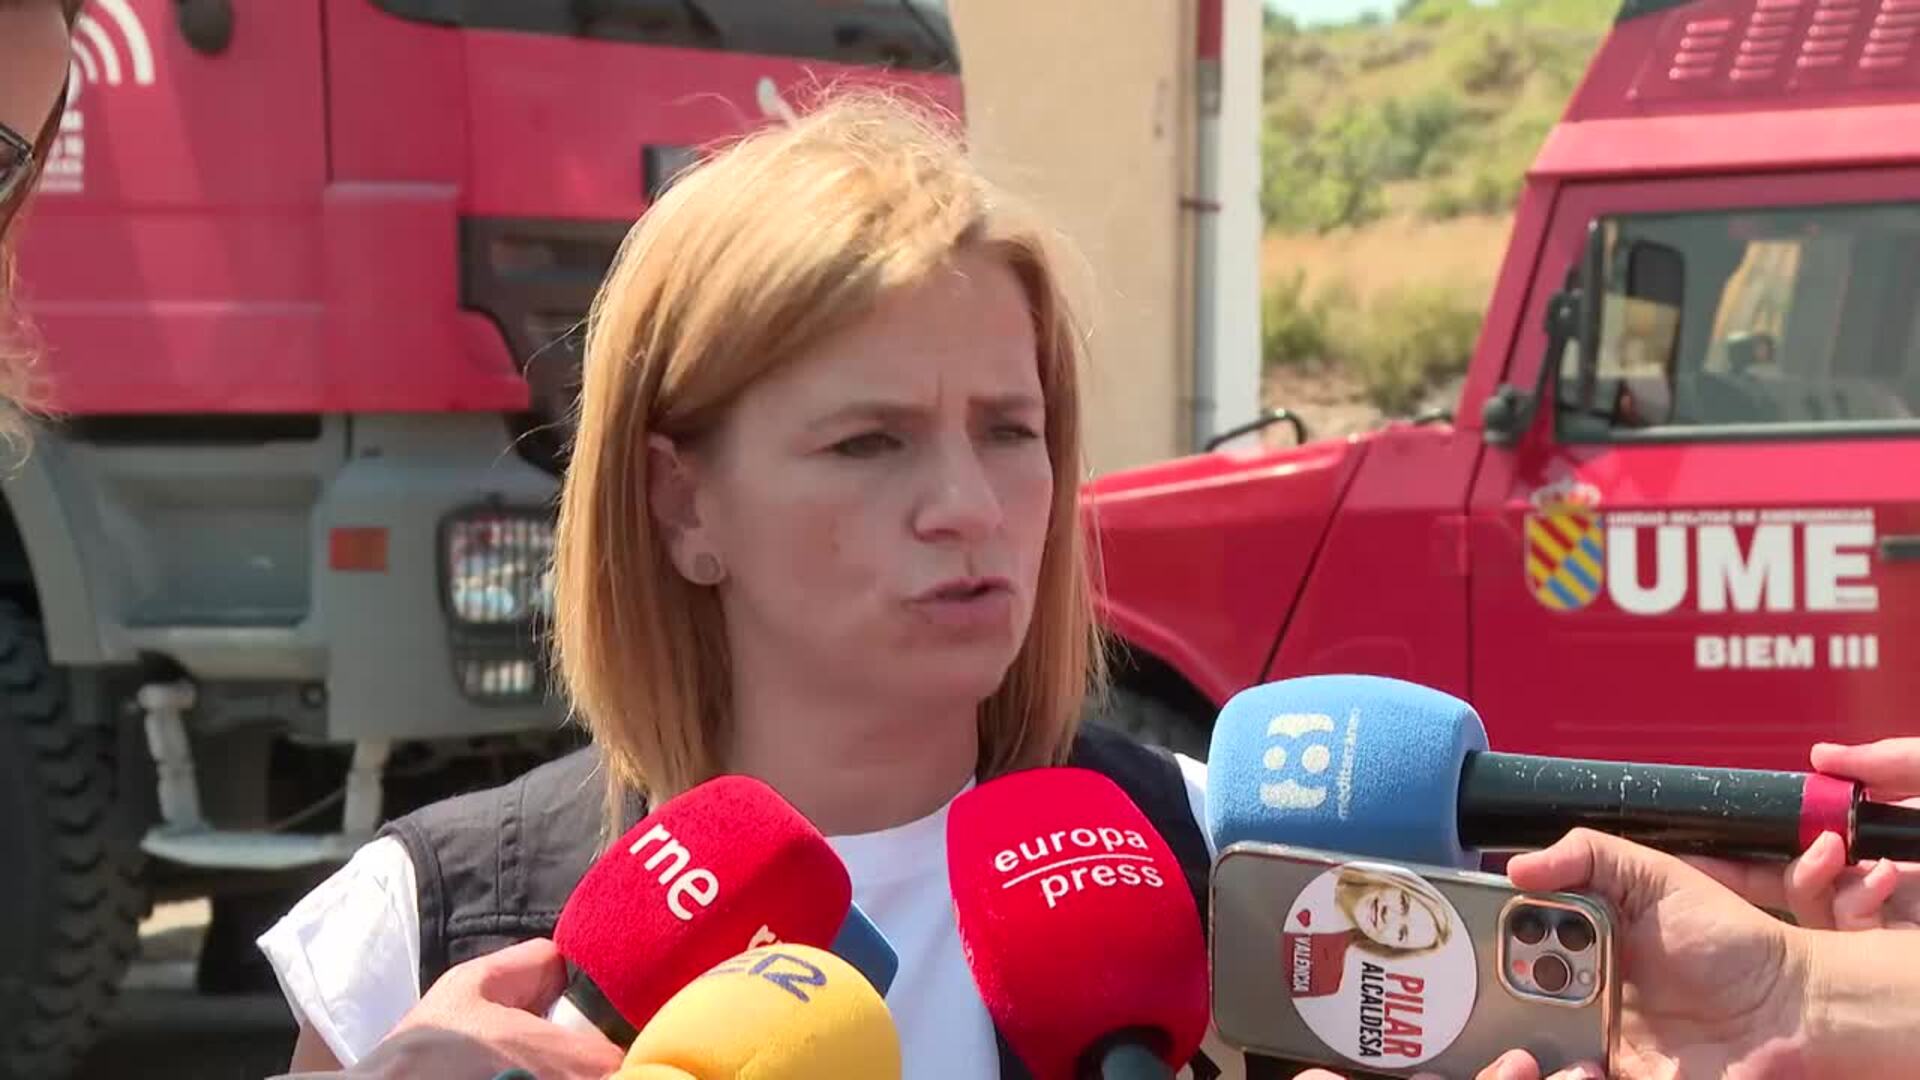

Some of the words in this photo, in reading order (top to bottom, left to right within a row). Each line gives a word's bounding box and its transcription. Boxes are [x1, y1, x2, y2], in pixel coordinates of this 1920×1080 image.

[1606, 523, 1879, 615] UME
[1694, 634, 1815, 669] BIEM
[1828, 633, 1879, 668] III
[629, 823, 720, 921] rne
[993, 827, 1149, 873] europa
[1040, 864, 1164, 909] press
[1359, 961, 1385, 1058] ALCALDESA
[1383, 973, 1425, 1059] PILAR
